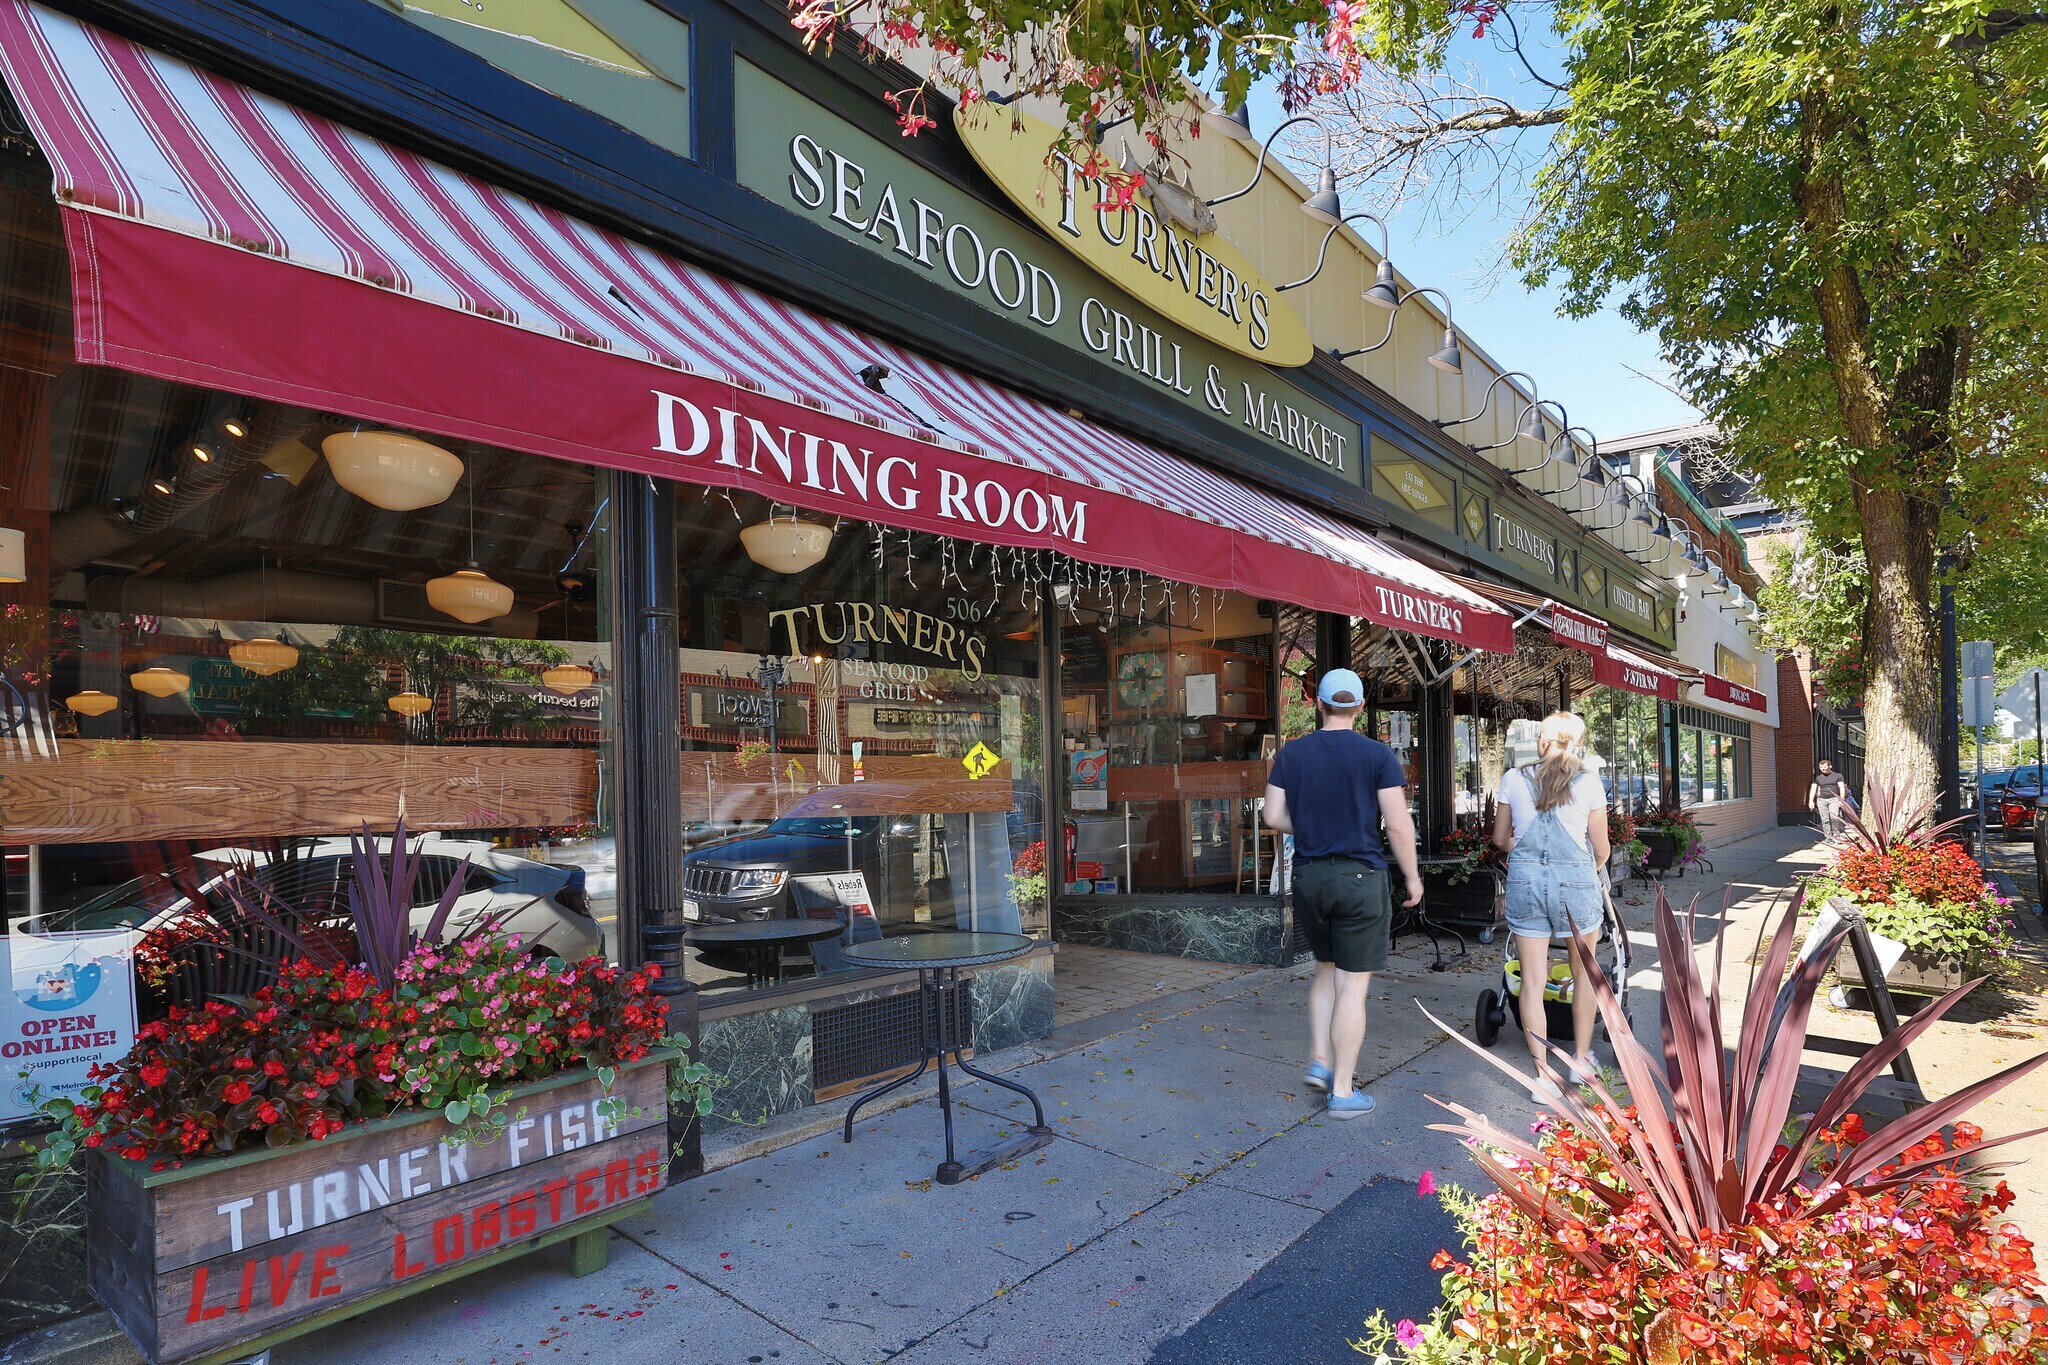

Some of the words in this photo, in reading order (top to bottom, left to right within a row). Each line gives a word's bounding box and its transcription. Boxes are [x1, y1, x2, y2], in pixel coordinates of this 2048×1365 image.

[1052, 148, 1271, 350] TURNER'S
[789, 133, 1063, 328] SEAFOOD
[1080, 296, 1193, 398] GRILL
[1204, 364, 1231, 417] &
[1242, 381, 1348, 474] MARKET
[649, 388, 921, 513] DINING
[937, 466, 1089, 546] ROOM
[1494, 512, 1555, 575] TURNER'S
[945, 596, 982, 622] 506
[1375, 585, 1463, 633] TURNER'S
[1613, 585, 1637, 614] OYSTER
[1638, 598, 1650, 621] BAR
[769, 601, 986, 682] TURNER'S
[843, 657, 929, 683] SEAFOOD
[860, 681, 916, 702] GRILL
[1, 1030, 117, 1058] ONLINE!
[21, 1014, 96, 1037] OPEN
[22, 1052, 102, 1070] #supportlocal
[61, 1079, 96, 1091] Melrose
[217, 1141, 470, 1253] TURNER
[185, 1244, 350, 1325] LIVE
[393, 1147, 662, 1280] LOBSTERS
